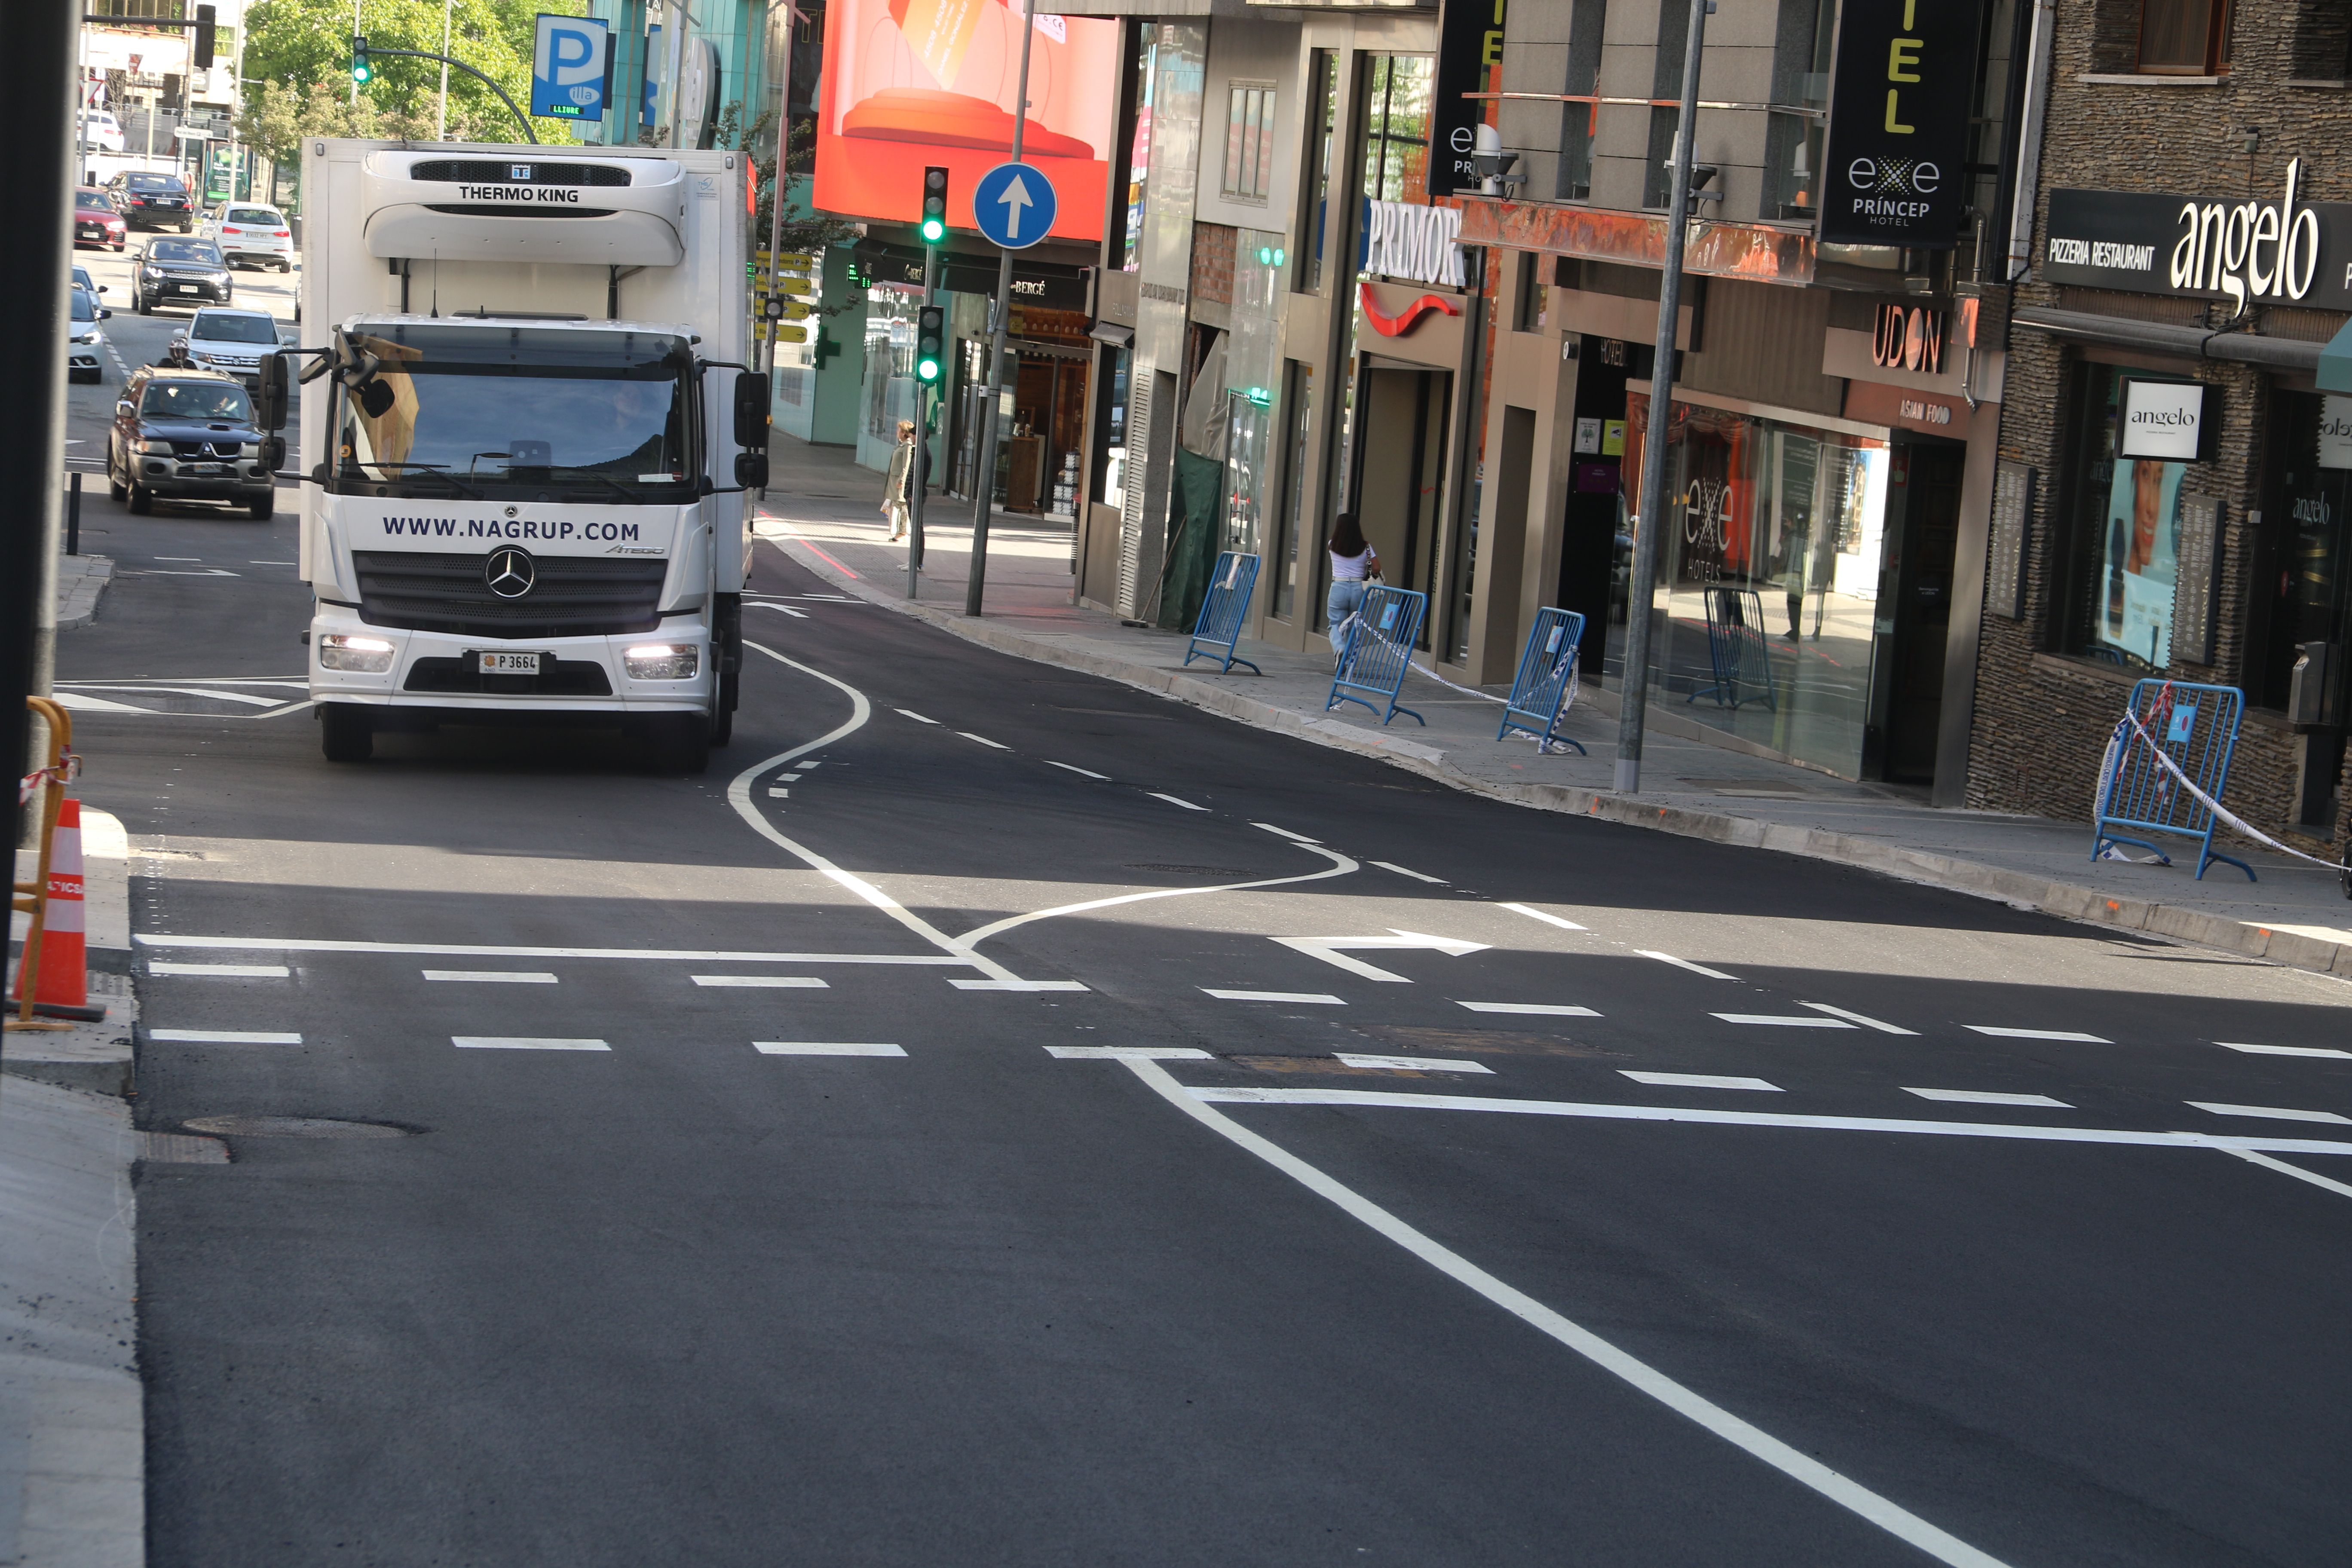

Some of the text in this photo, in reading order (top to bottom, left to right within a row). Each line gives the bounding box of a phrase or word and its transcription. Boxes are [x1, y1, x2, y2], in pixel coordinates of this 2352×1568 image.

[548, 28, 593, 85] P
[573, 87, 592, 100] illa
[553, 105, 579, 114] LLIURE
[459, 186, 578, 203] THERMO KING
[1853, 196, 1929, 217] PRÍNCEP
[1870, 217, 1909, 227] HOTEL
[1366, 199, 1461, 287] PRIMOR
[2171, 157, 2319, 318] angelo
[2049, 238, 2155, 271] PIZZERIA RESTAURANT
[1016, 280, 1045, 296] BERGÉ
[1873, 303, 1942, 374] UDON
[1900, 400, 1950, 425] ASIAN FOOD
[2132, 408, 2194, 427] angelo
[2293, 491, 2330, 526] angelo
[383, 517, 639, 541] WWW.NAGRUP.COM
[1687, 557, 1721, 584] HOTELS
[499, 656, 535, 668] P 3664
